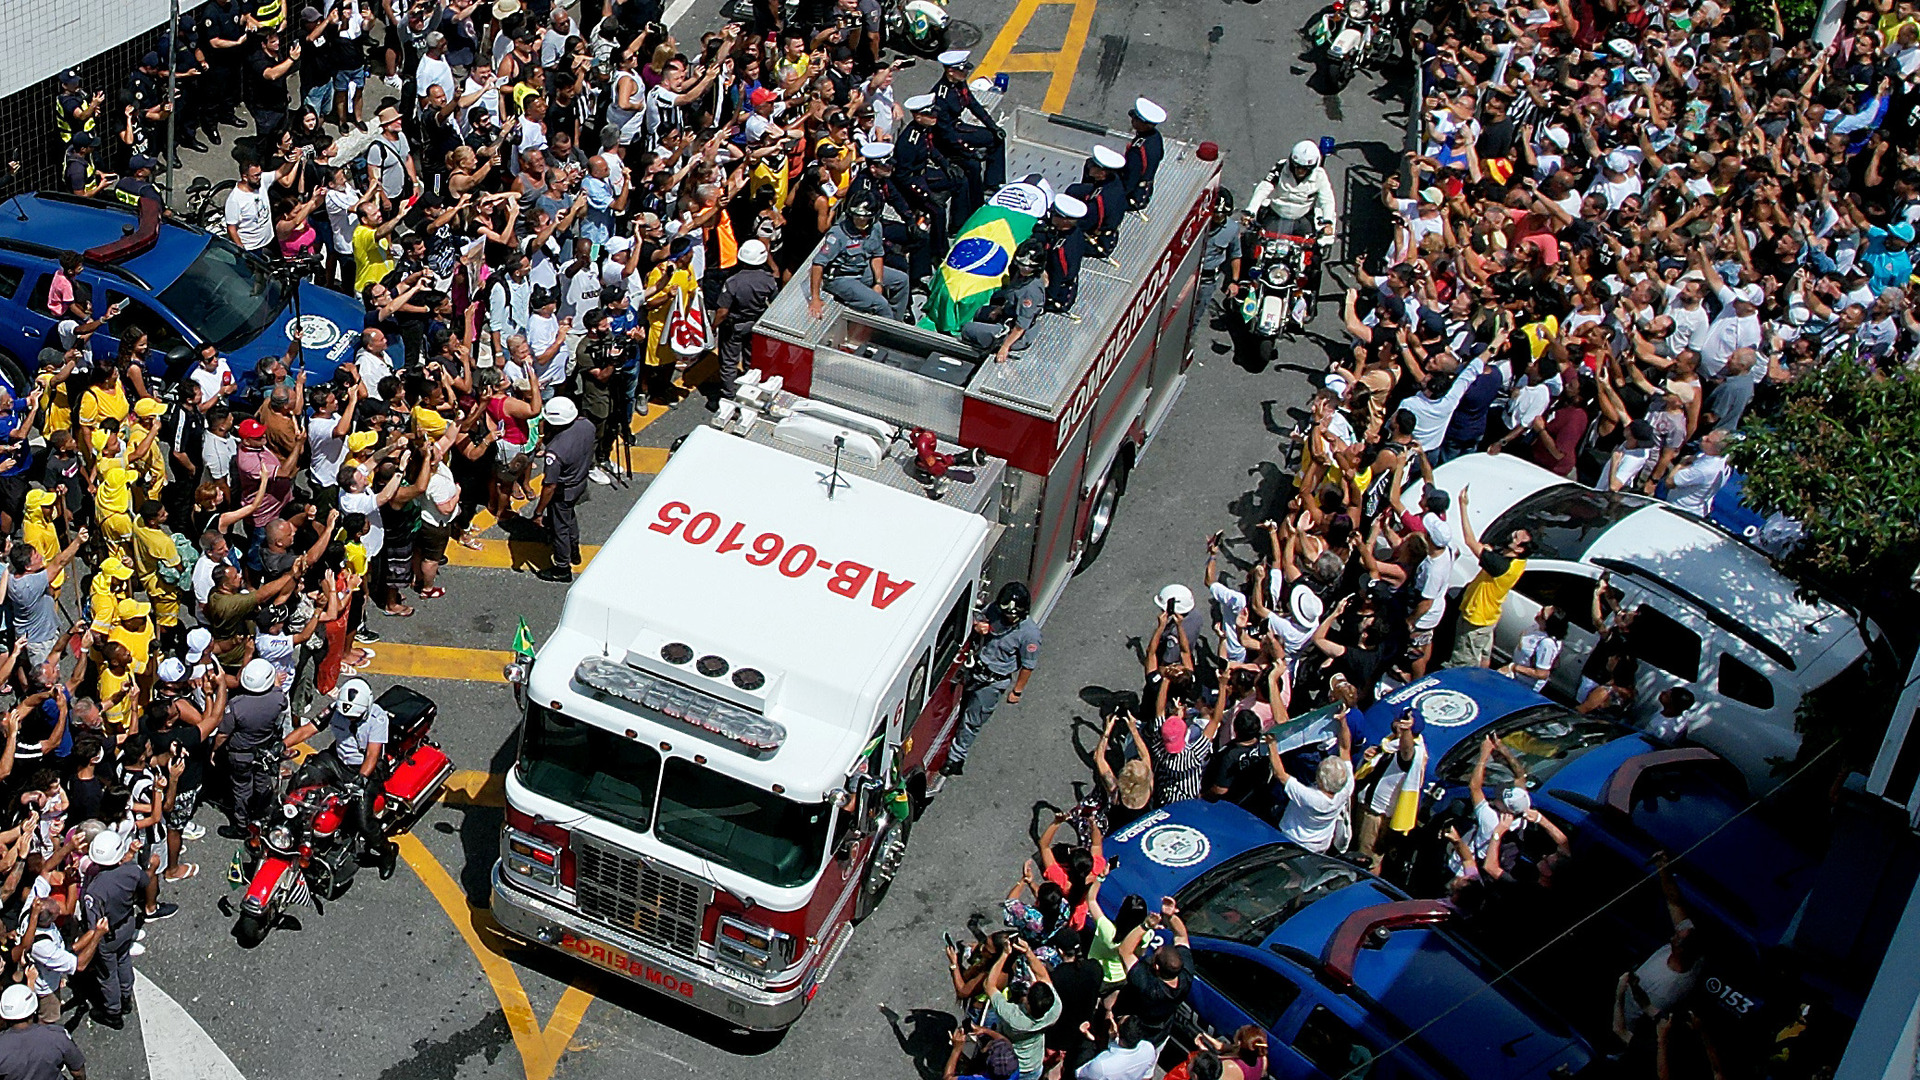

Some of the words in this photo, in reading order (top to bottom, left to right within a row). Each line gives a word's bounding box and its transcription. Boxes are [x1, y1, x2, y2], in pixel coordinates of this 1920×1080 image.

[1056, 250, 1172, 450] BOMBEIROS
[648, 501, 915, 610] AB-06105
[1386, 678, 1441, 705] GUARDA
[1423, 782, 1446, 801] 18
[1114, 811, 1171, 843] GUARDA
[1719, 985, 1755, 1014] 153
